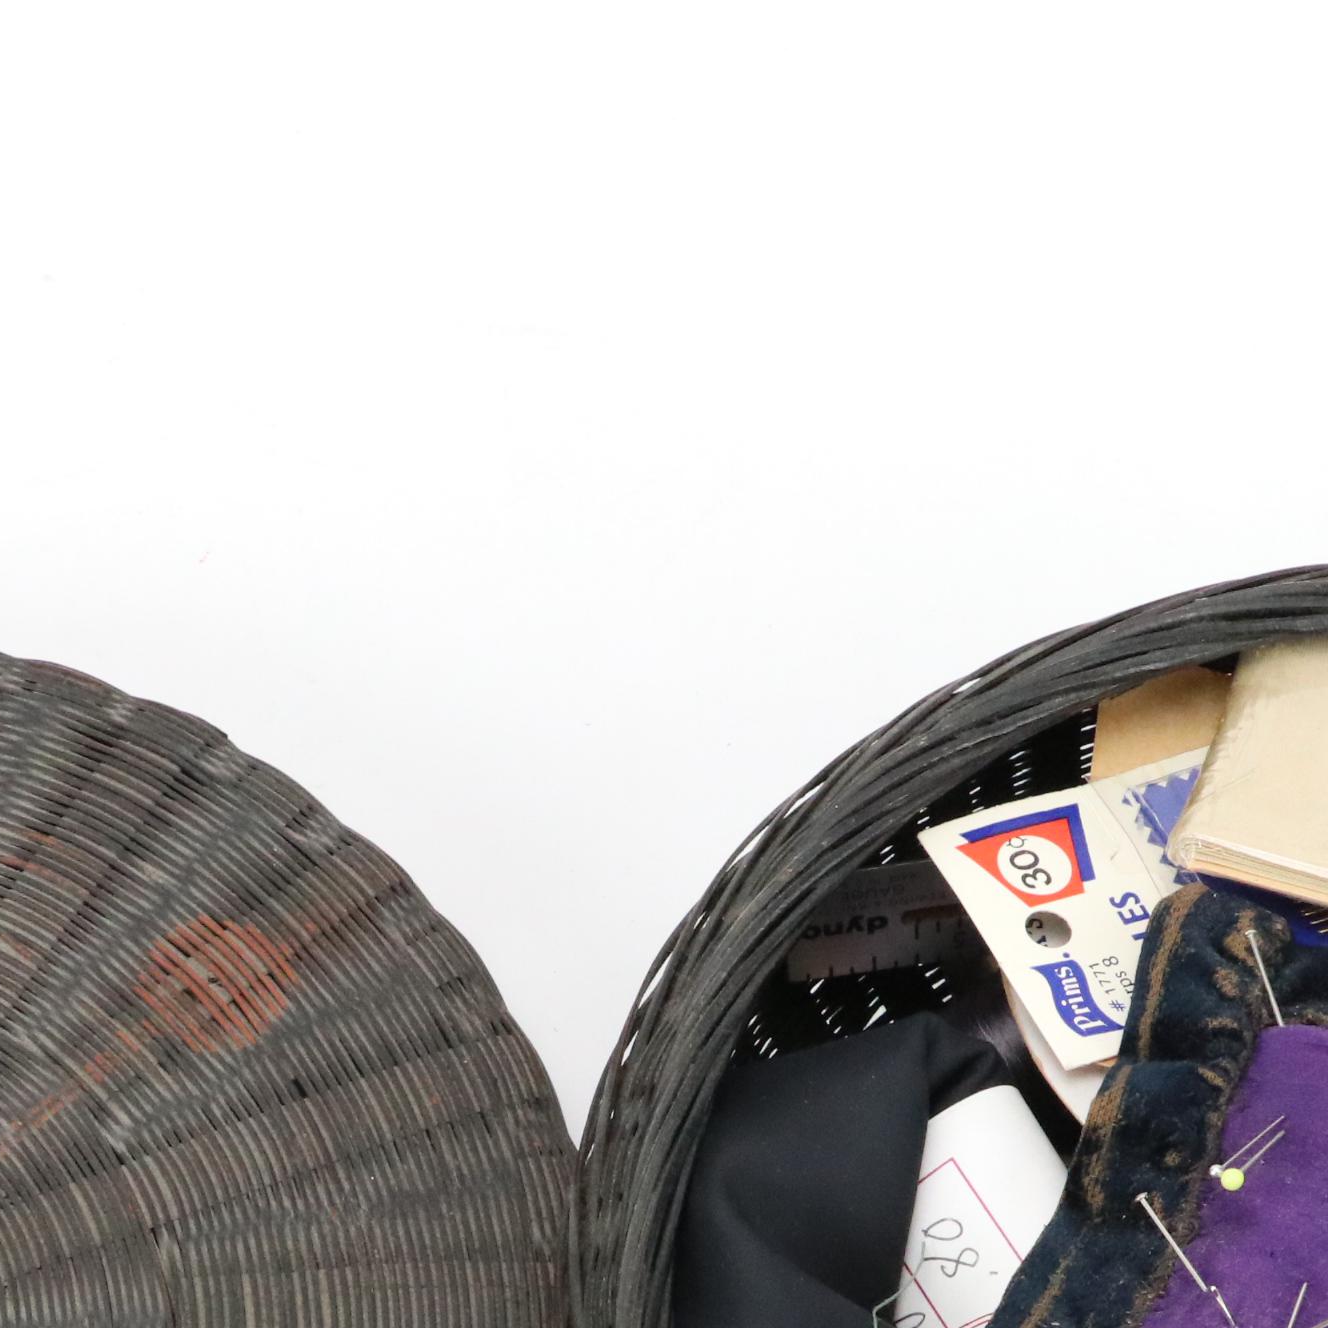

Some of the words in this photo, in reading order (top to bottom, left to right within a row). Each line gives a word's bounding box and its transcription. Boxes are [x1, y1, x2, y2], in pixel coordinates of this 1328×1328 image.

[1006, 836, 1053, 889] 30¢
[1102, 955, 1119, 967] 8
[1116, 971, 1135, 999] rps
